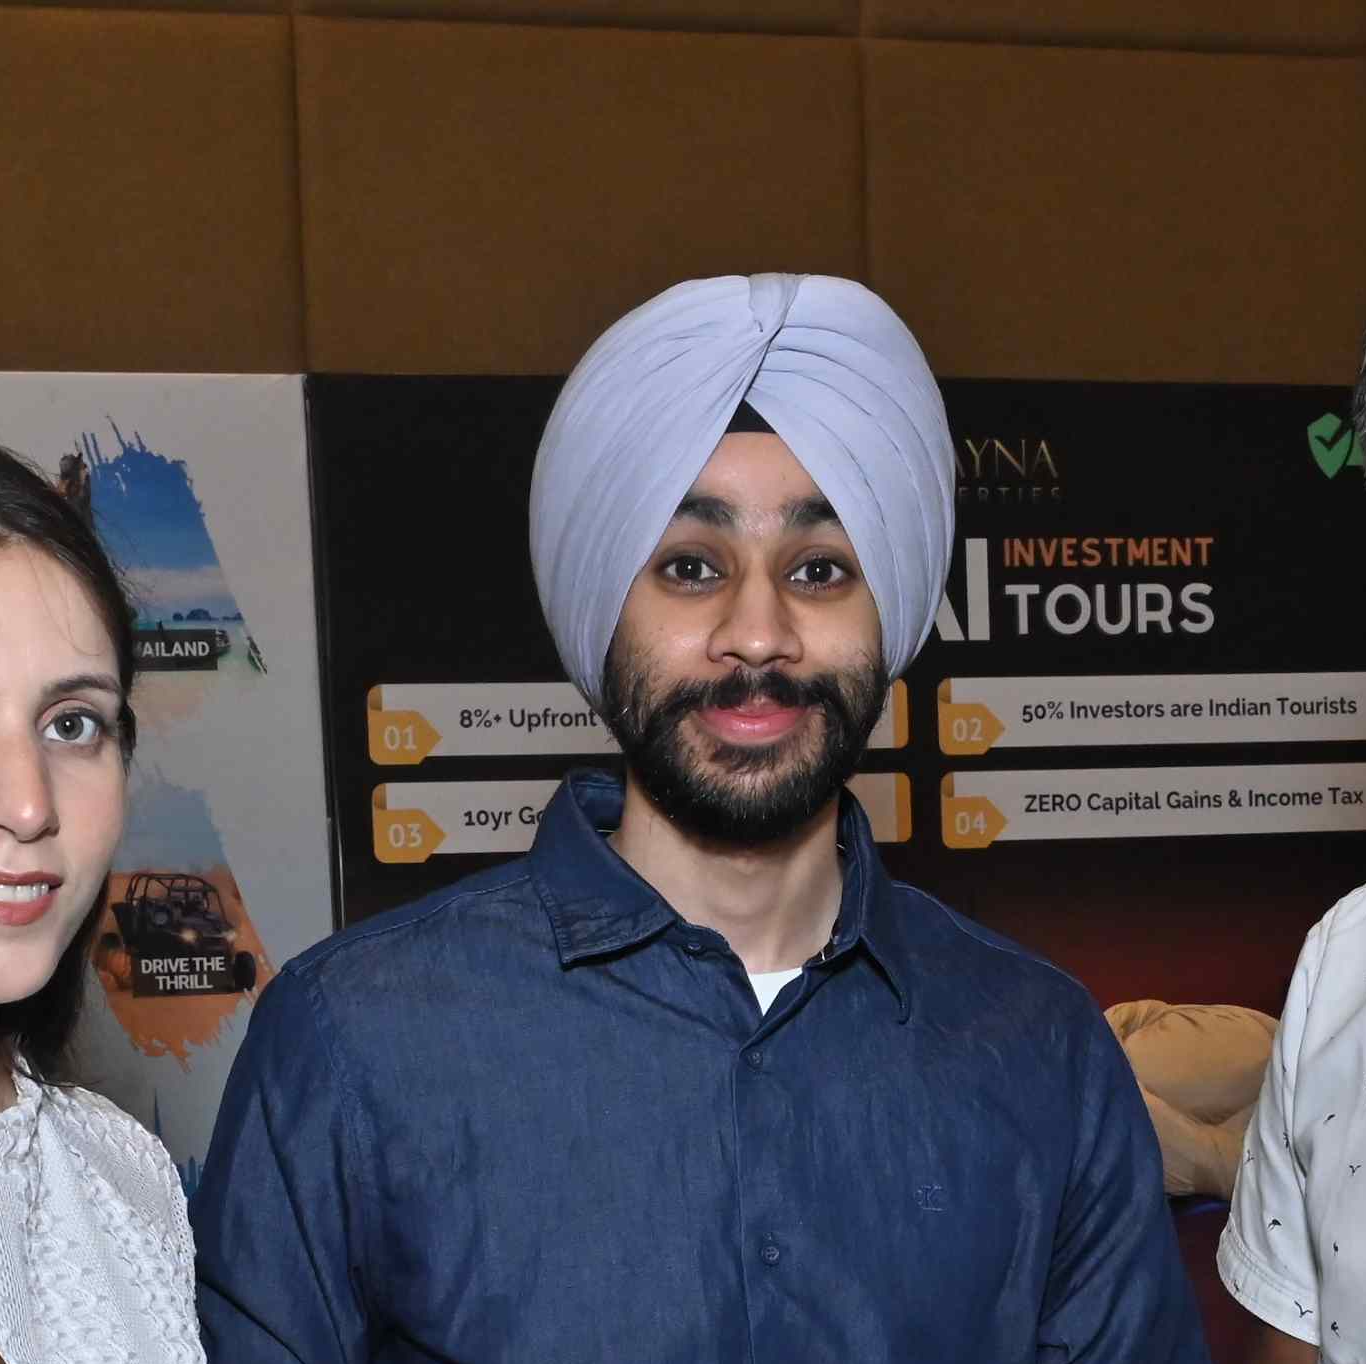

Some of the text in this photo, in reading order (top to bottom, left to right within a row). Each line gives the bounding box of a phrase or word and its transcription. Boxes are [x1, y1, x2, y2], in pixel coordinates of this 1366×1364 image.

[955, 439, 1059, 479] YNA
[958, 486, 1061, 504] ERTIES
[1003, 536, 1214, 568] INVESTMENT
[1004, 582, 1216, 638] TOURS
[134, 641, 210, 657] AILAND
[458, 708, 597, 733] 8%+ Upfront
[1022, 696, 1358, 725] 50% Investors are Indian Tourists
[383, 725, 418, 751] 01
[952, 719, 983, 743] 02
[1024, 786, 1364, 817] ZERO Capital Gains & Income Tax
[463, 809, 513, 831] 10yr
[954, 812, 988, 836] 04
[389, 822, 423, 849] 03
[140, 956, 225, 974] DRIVE THE
[154, 975, 213, 990] THRILL
